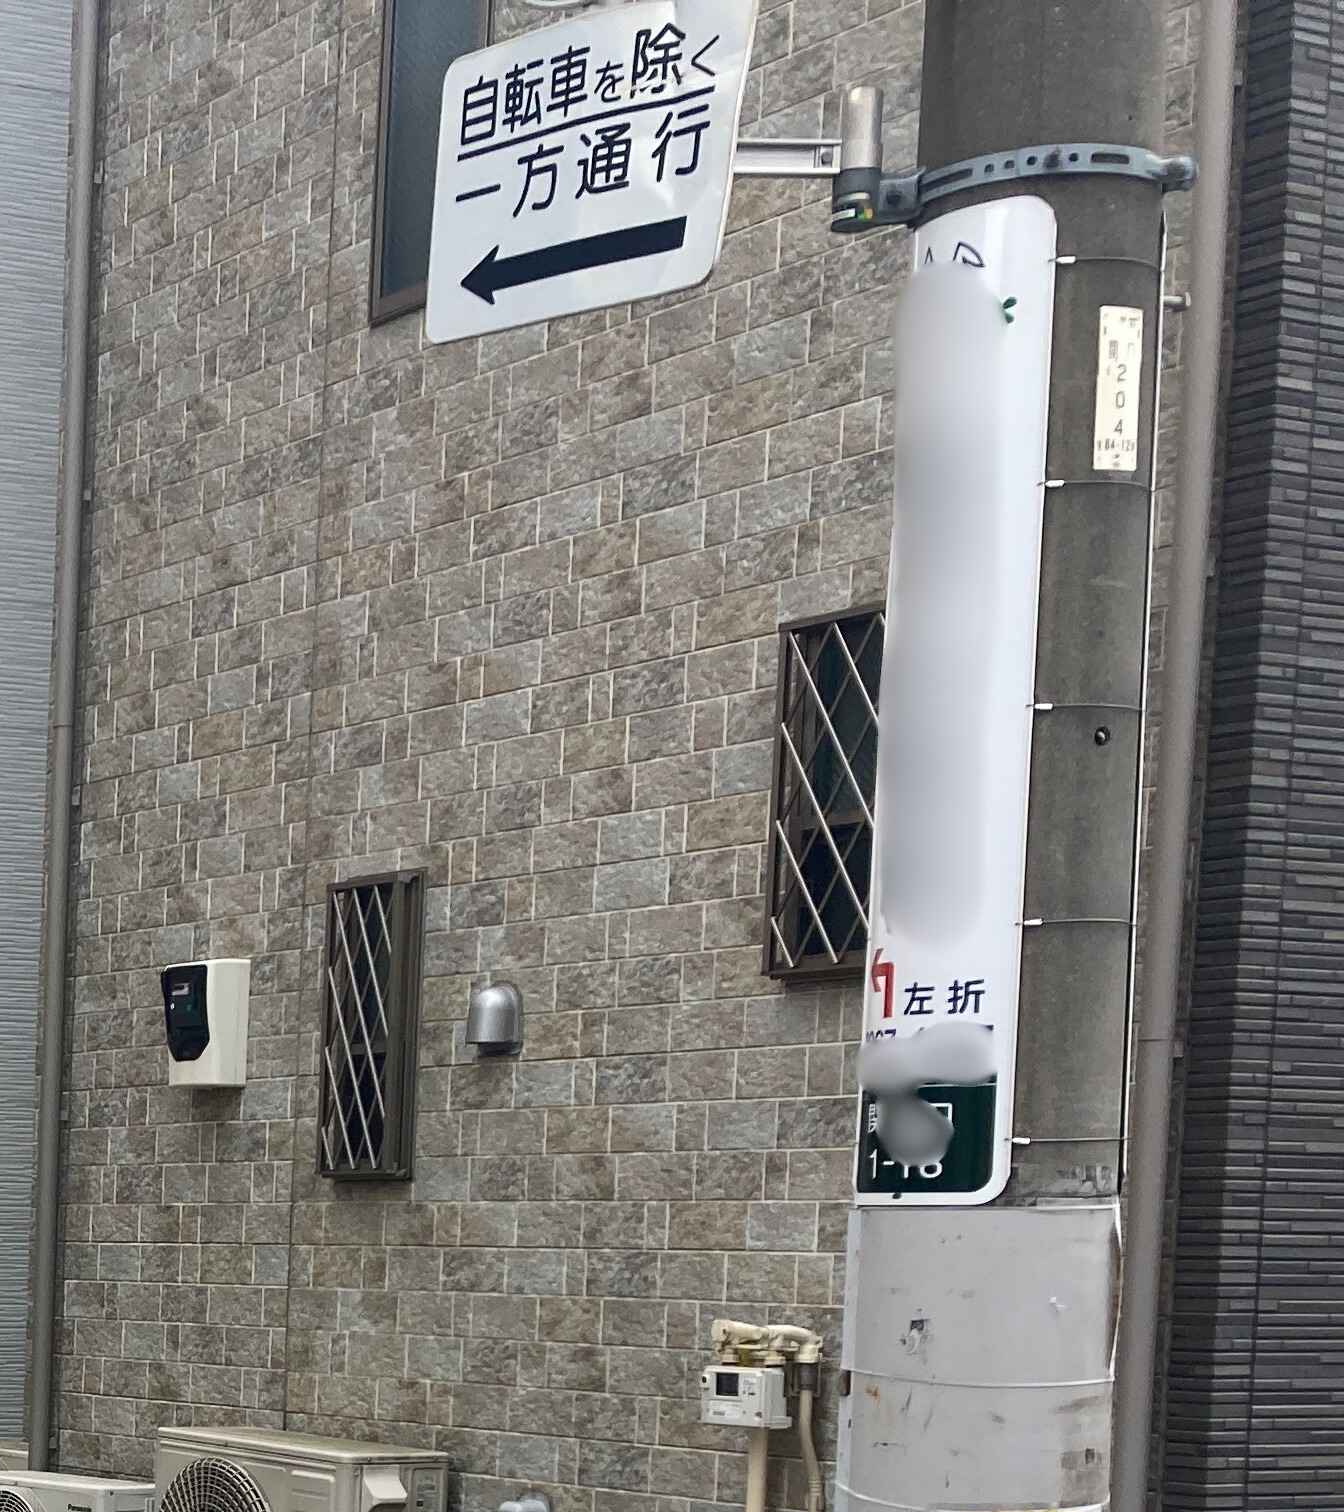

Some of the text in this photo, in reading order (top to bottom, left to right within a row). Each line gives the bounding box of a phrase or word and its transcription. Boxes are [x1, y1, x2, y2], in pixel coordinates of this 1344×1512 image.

[460, 22, 721, 146] 自転車を除く
[455, 104, 712, 218] 一方通行
[903, 978, 986, 1016] 左折
